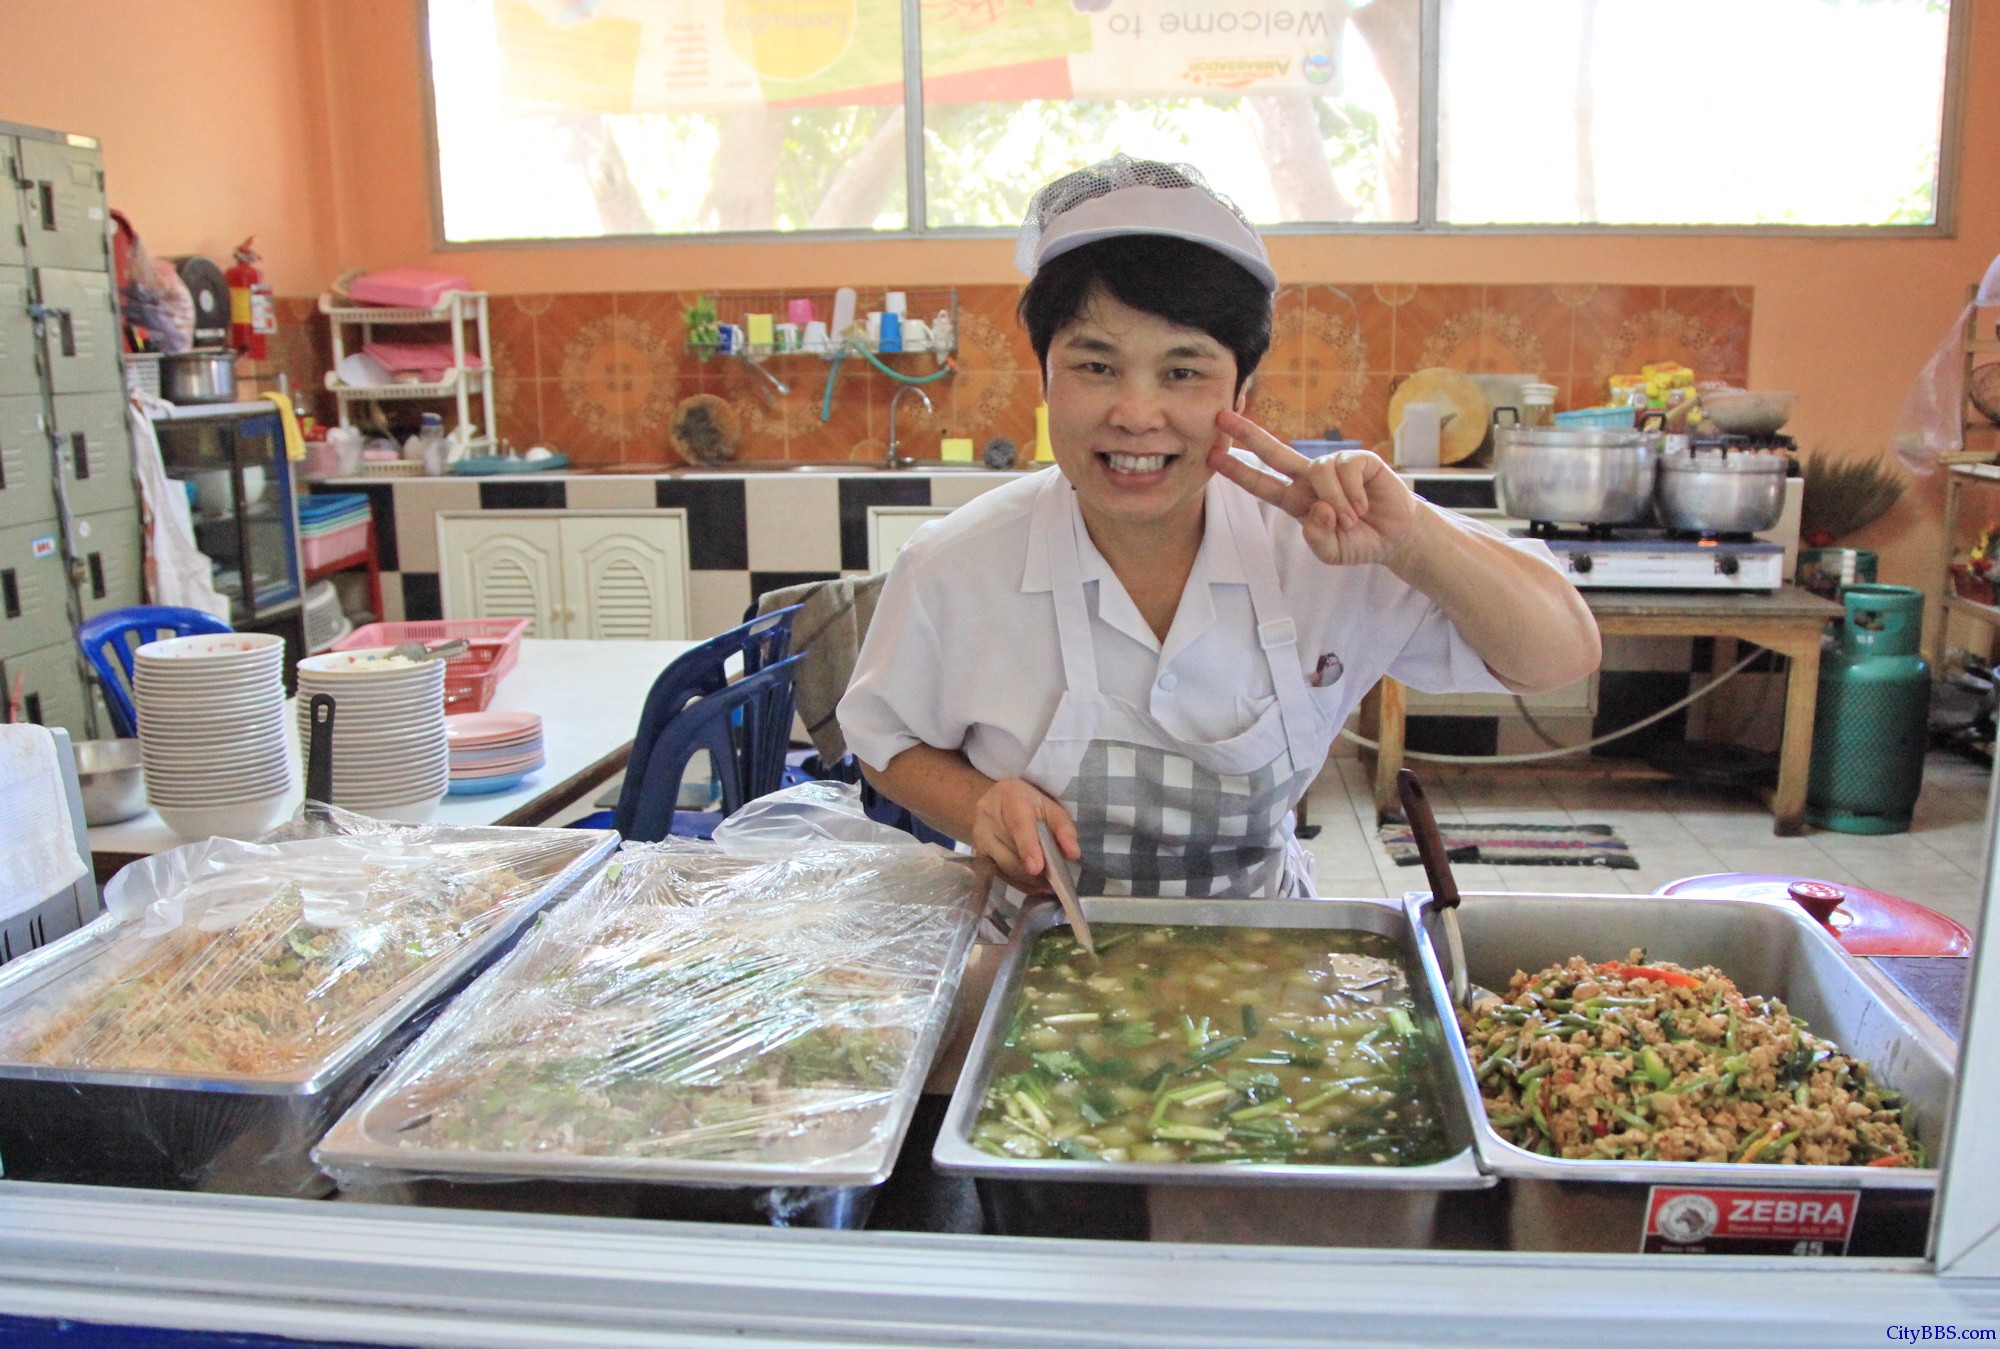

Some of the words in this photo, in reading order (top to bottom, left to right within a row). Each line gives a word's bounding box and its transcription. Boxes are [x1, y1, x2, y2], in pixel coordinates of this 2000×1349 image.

[1109, 13, 1143, 39] to
[1159, 10, 1329, 36] Welcome
[1727, 1199, 1845, 1224] ZEBRA
